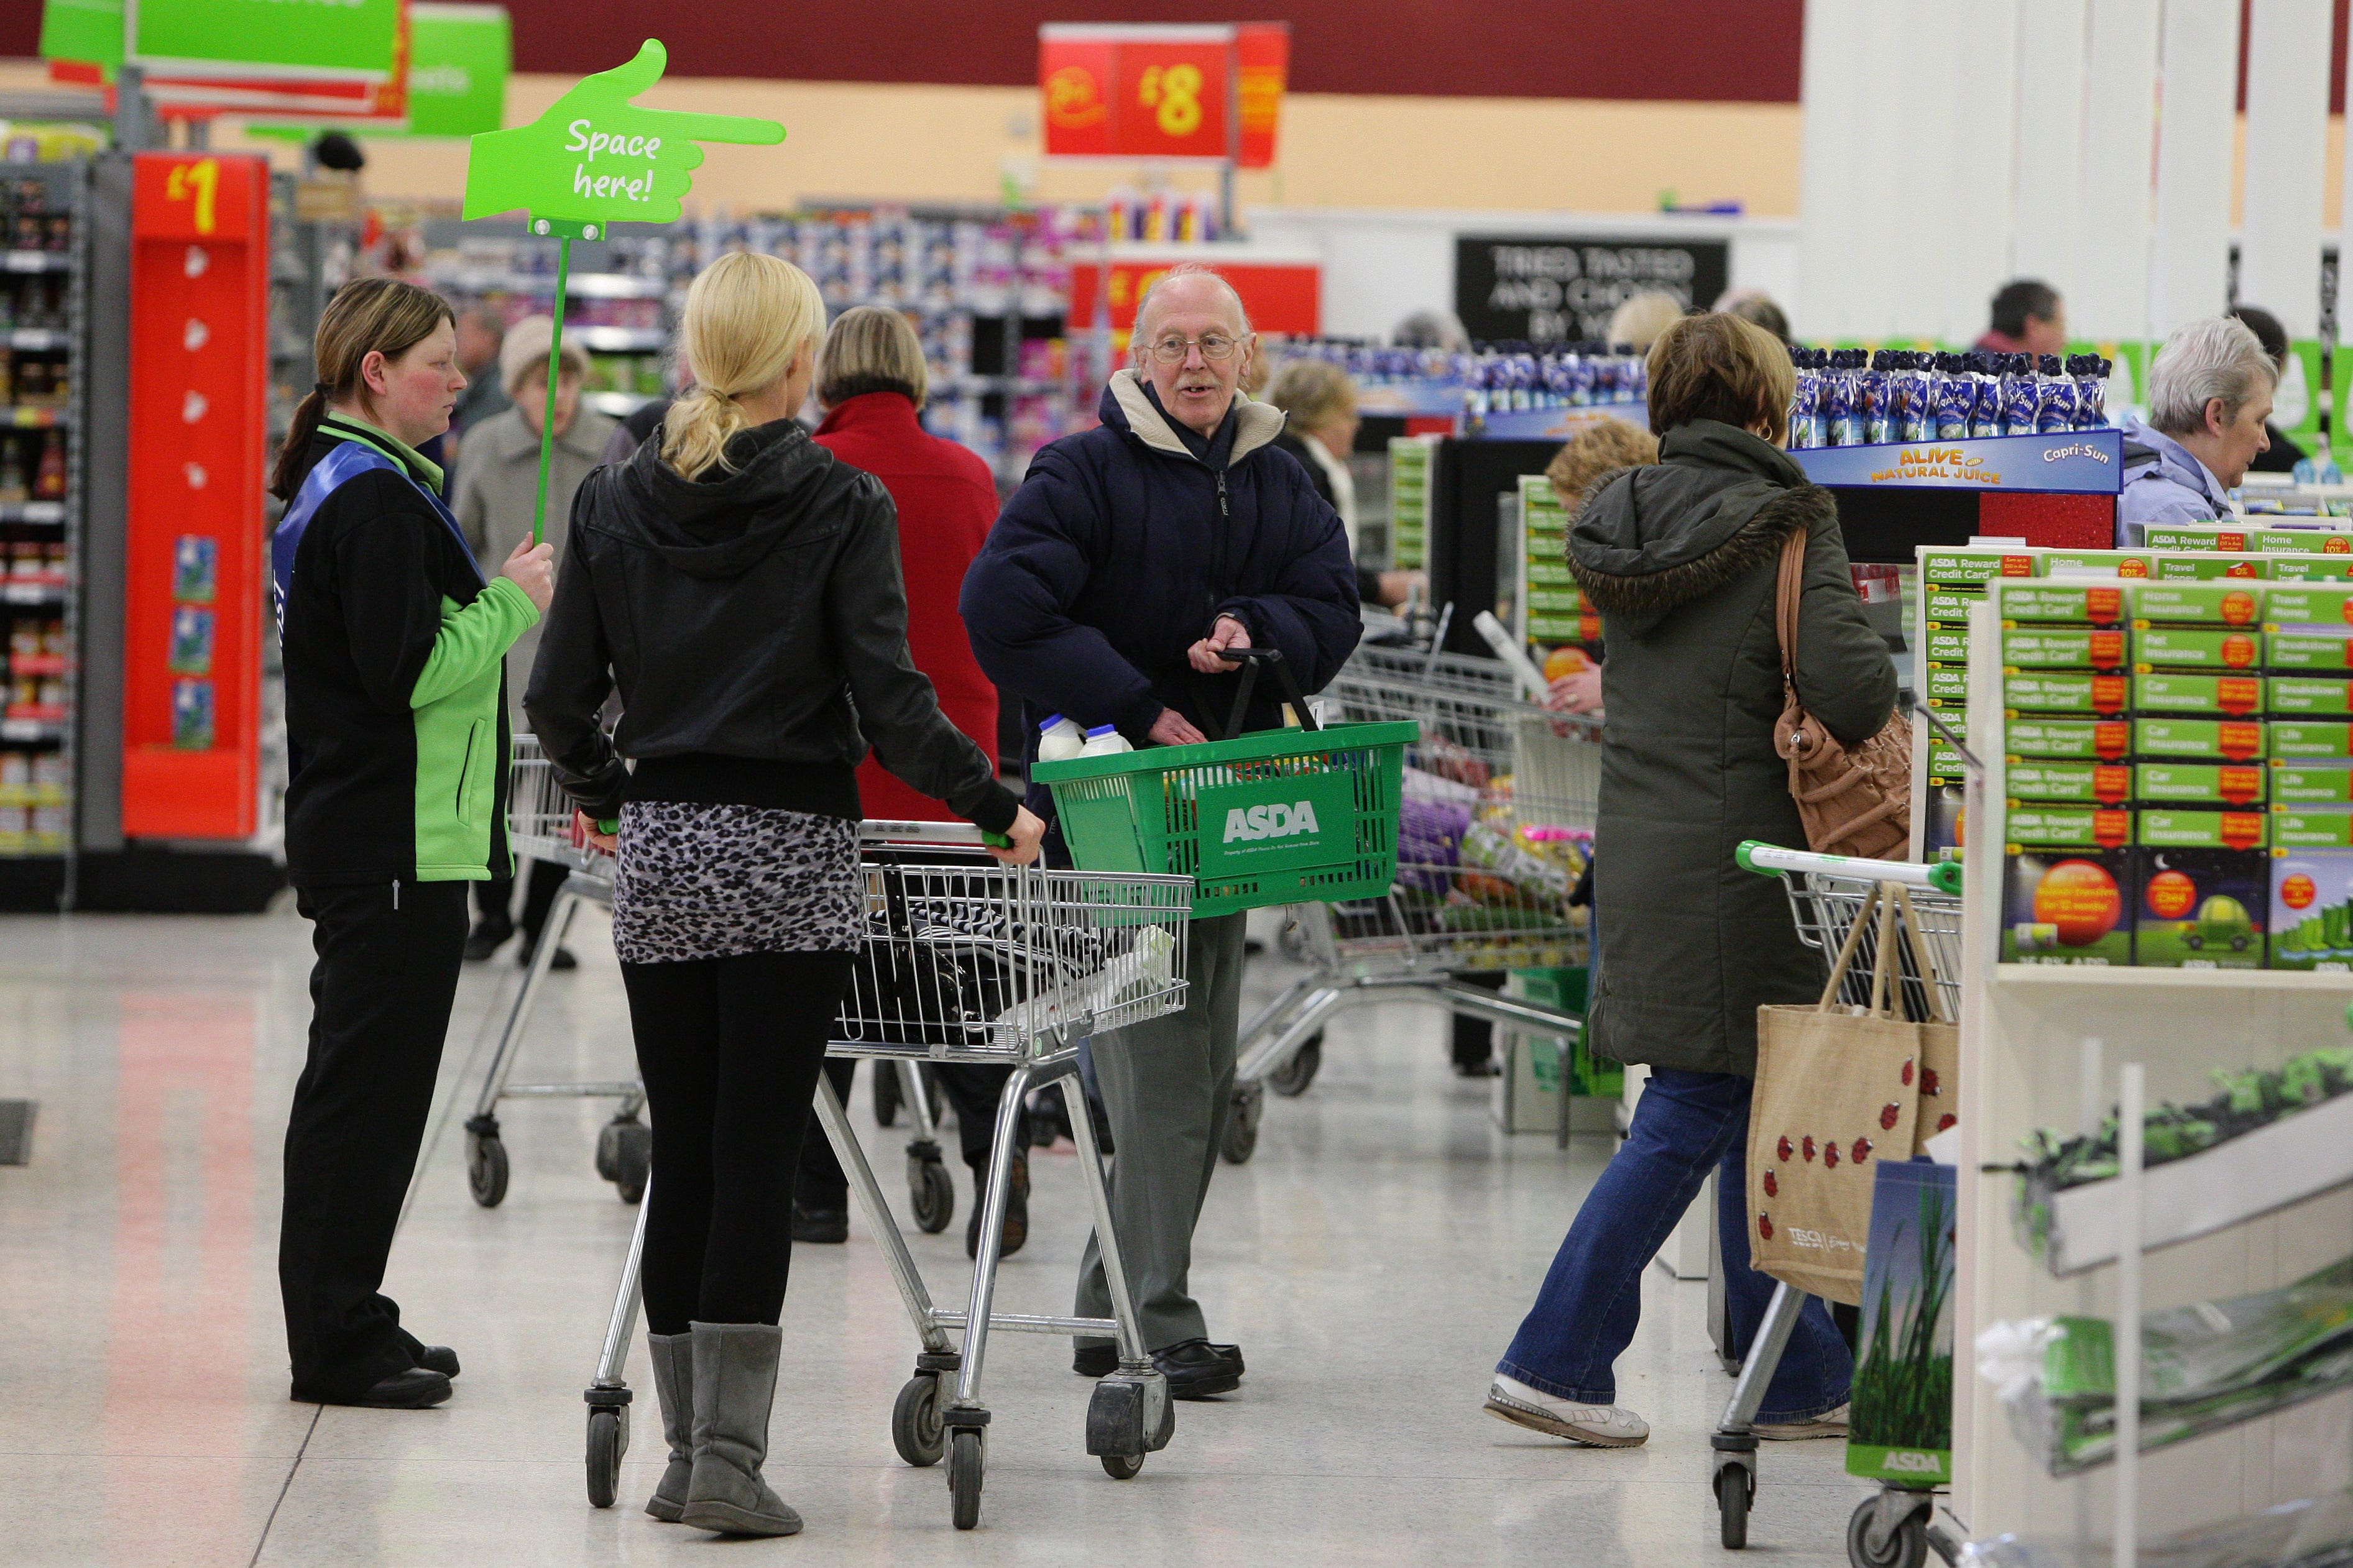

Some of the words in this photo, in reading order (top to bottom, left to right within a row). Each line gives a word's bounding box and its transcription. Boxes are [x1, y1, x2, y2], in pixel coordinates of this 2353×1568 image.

[564, 119, 661, 162] Space
[573, 163, 653, 202] here!
[1900, 447, 1964, 465] ALIVE
[2043, 443, 2109, 464] Capri-Sun
[1871, 466, 1949, 483] NATURAL
[1954, 468, 2001, 484] JUICE
[2152, 535, 2176, 544] ASDA
[2180, 536, 2216, 545] Reward
[2262, 535, 2292, 544] Home
[1929, 558, 1958, 567] ASDA
[1961, 559, 2001, 568] Reward
[2050, 557, 2083, 566] Home
[2164, 563, 2194, 572] Travel
[2278, 564, 2309, 572] Travel
[1929, 569, 1962, 579] Credit
[2120, 569, 2138, 577] 10%
[1932, 596, 1958, 605] ASDA
[1932, 607, 1963, 617] Credit
[1932, 636, 1959, 645] ASDA
[1932, 647, 1963, 656] Credit
[1932, 673, 1959, 682] ASDA
[1932, 684, 1964, 694] Credit
[1223, 800, 1319, 843] ASDA
[1882, 1451, 1941, 1473] ASDA
